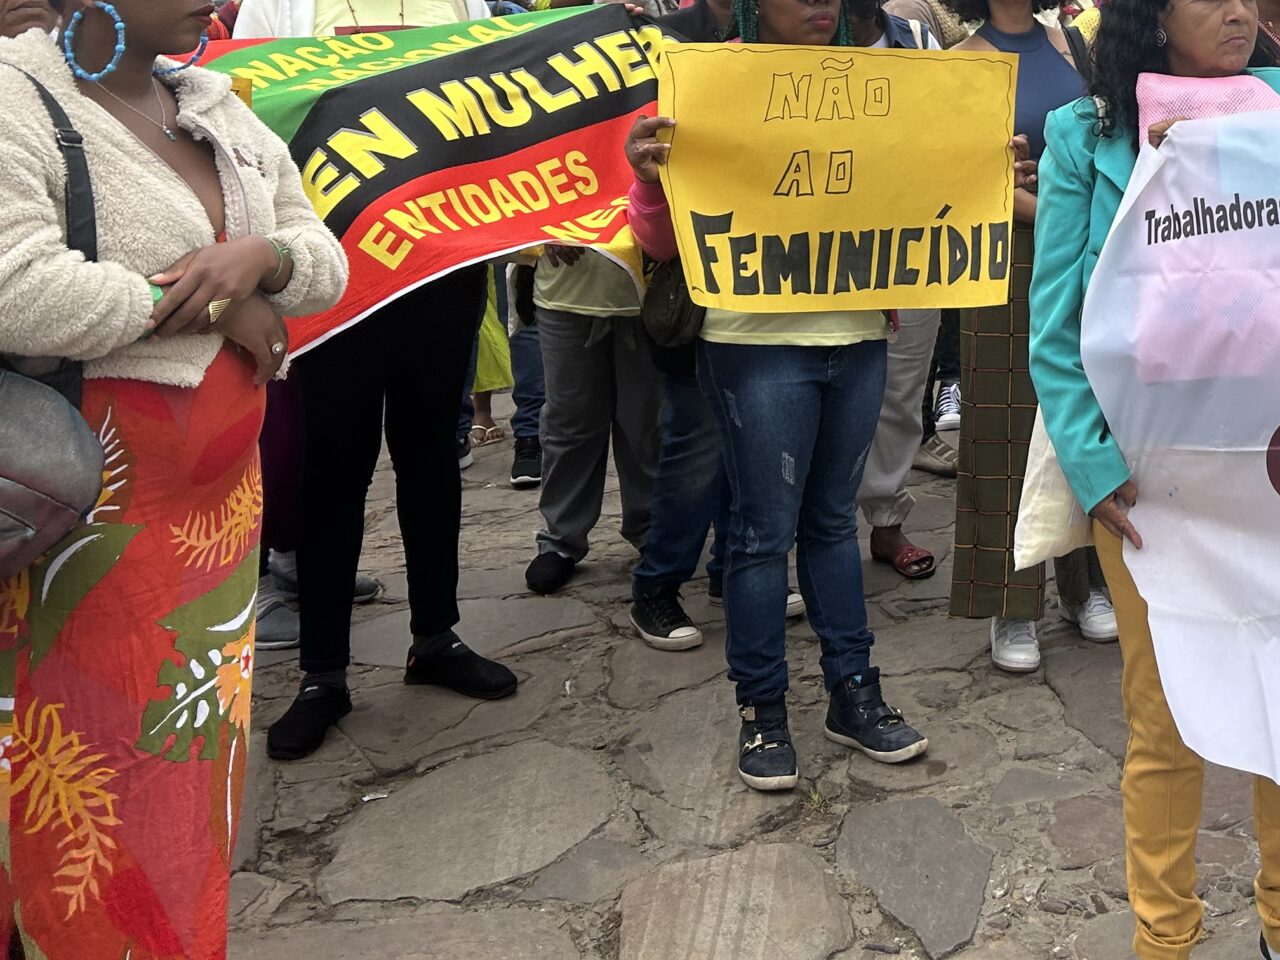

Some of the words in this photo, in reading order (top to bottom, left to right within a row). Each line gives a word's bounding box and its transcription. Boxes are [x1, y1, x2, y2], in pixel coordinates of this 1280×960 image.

[230, 32, 394, 89] NAÇÃO
[405, 25, 680, 141] MULHER
[764, 57, 890, 122] NÃO
[773, 149, 853, 197] AO
[357, 150, 599, 271] ENTIDADES
